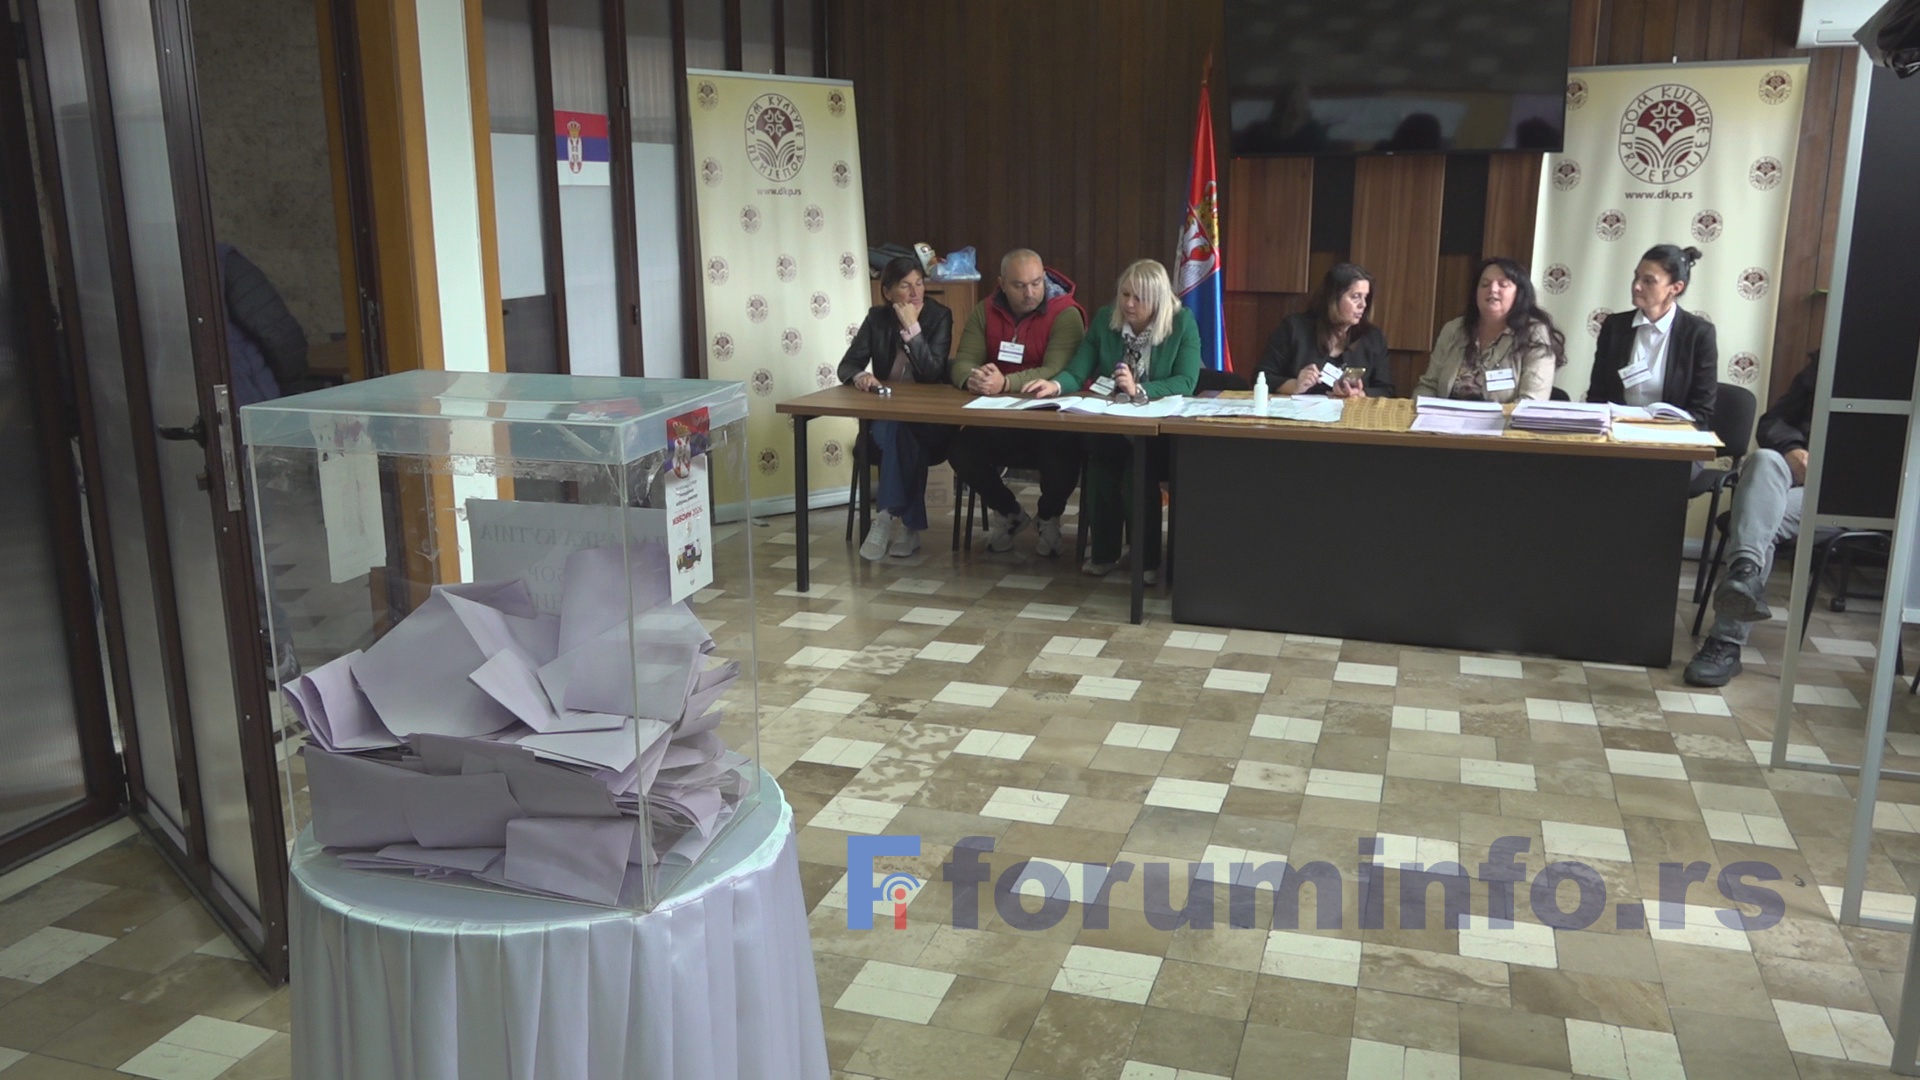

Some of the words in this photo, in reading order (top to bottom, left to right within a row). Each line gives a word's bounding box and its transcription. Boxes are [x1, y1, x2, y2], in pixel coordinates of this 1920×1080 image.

[747, 102, 763, 135] ДОМ
[1621, 94, 1654, 135] DOM
[1661, 86, 1710, 134] KULTURE
[1621, 141, 1708, 183] PRIJEPOLJE
[1625, 189, 1694, 202] www.dkp.rs
